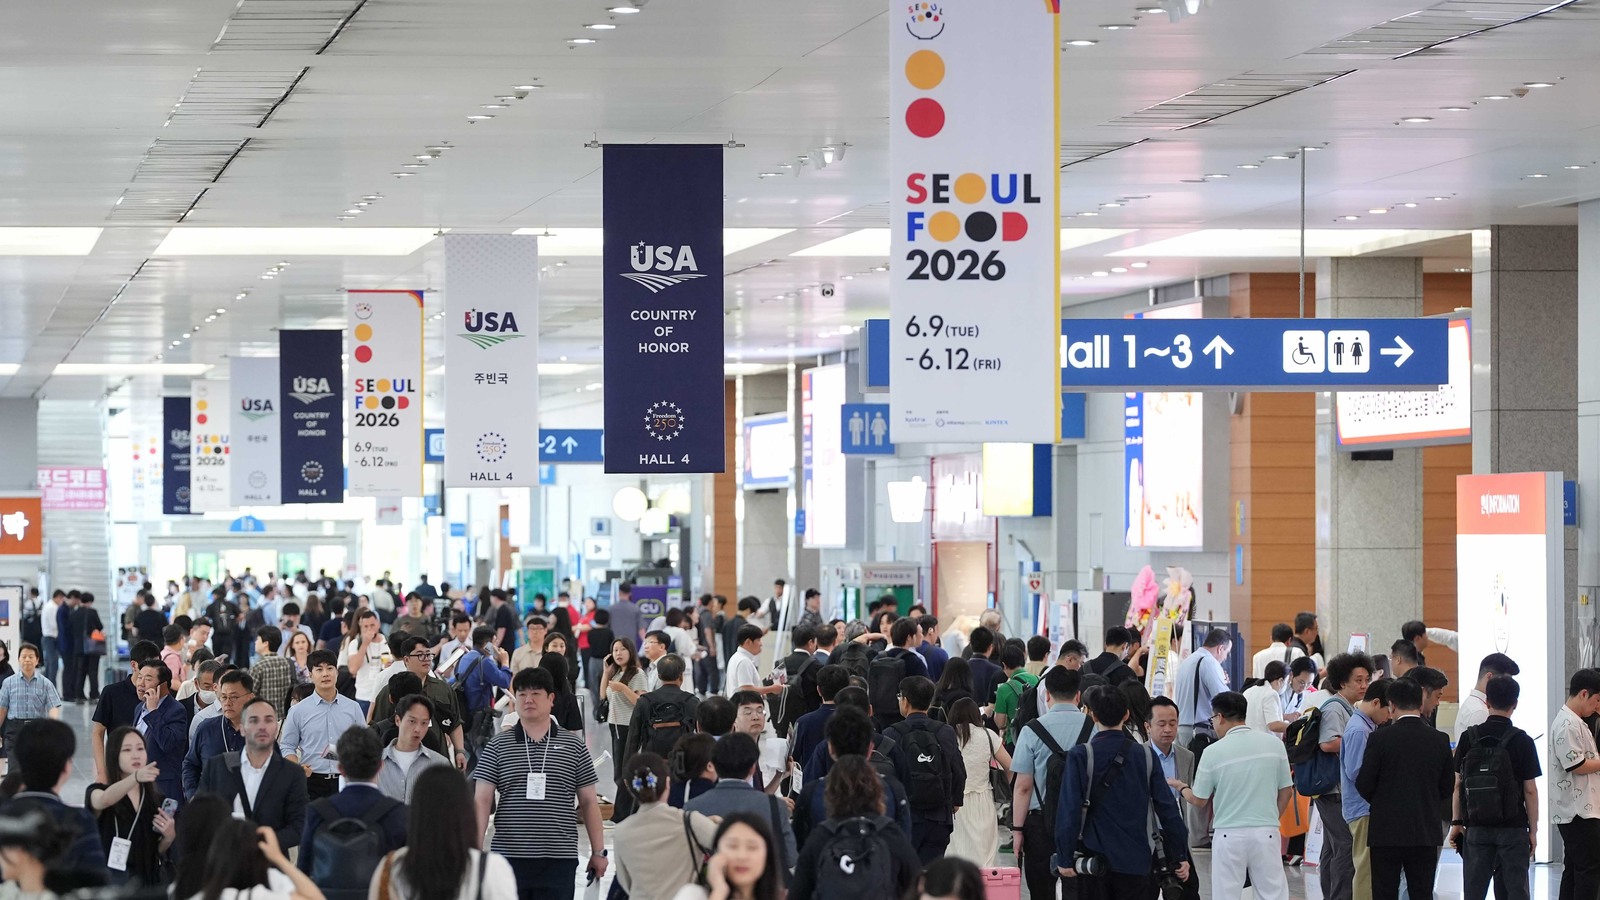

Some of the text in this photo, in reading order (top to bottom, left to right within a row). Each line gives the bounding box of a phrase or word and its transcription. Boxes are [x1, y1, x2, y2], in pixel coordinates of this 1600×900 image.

[906, 173, 1041, 204] SEOUL
[907, 211, 1028, 242] FOOD
[631, 243, 698, 271] USA
[906, 249, 1006, 281] 2026
[464, 310, 519, 333] USA
[630, 310, 697, 321] COUNTRY
[654, 326, 673, 337] OF
[638, 342, 689, 353] HONOR
[293, 376, 331, 393] USA
[355, 378, 415, 393] SEOUL
[474, 372, 509, 385] 주빈국
[242, 399, 273, 412] USA
[355, 396, 410, 410] FOOD
[355, 413, 400, 427] 2026
[653, 418, 677, 431] 250
[639, 454, 690, 465] HALL 4
[470, 472, 513, 481] HALL 4
